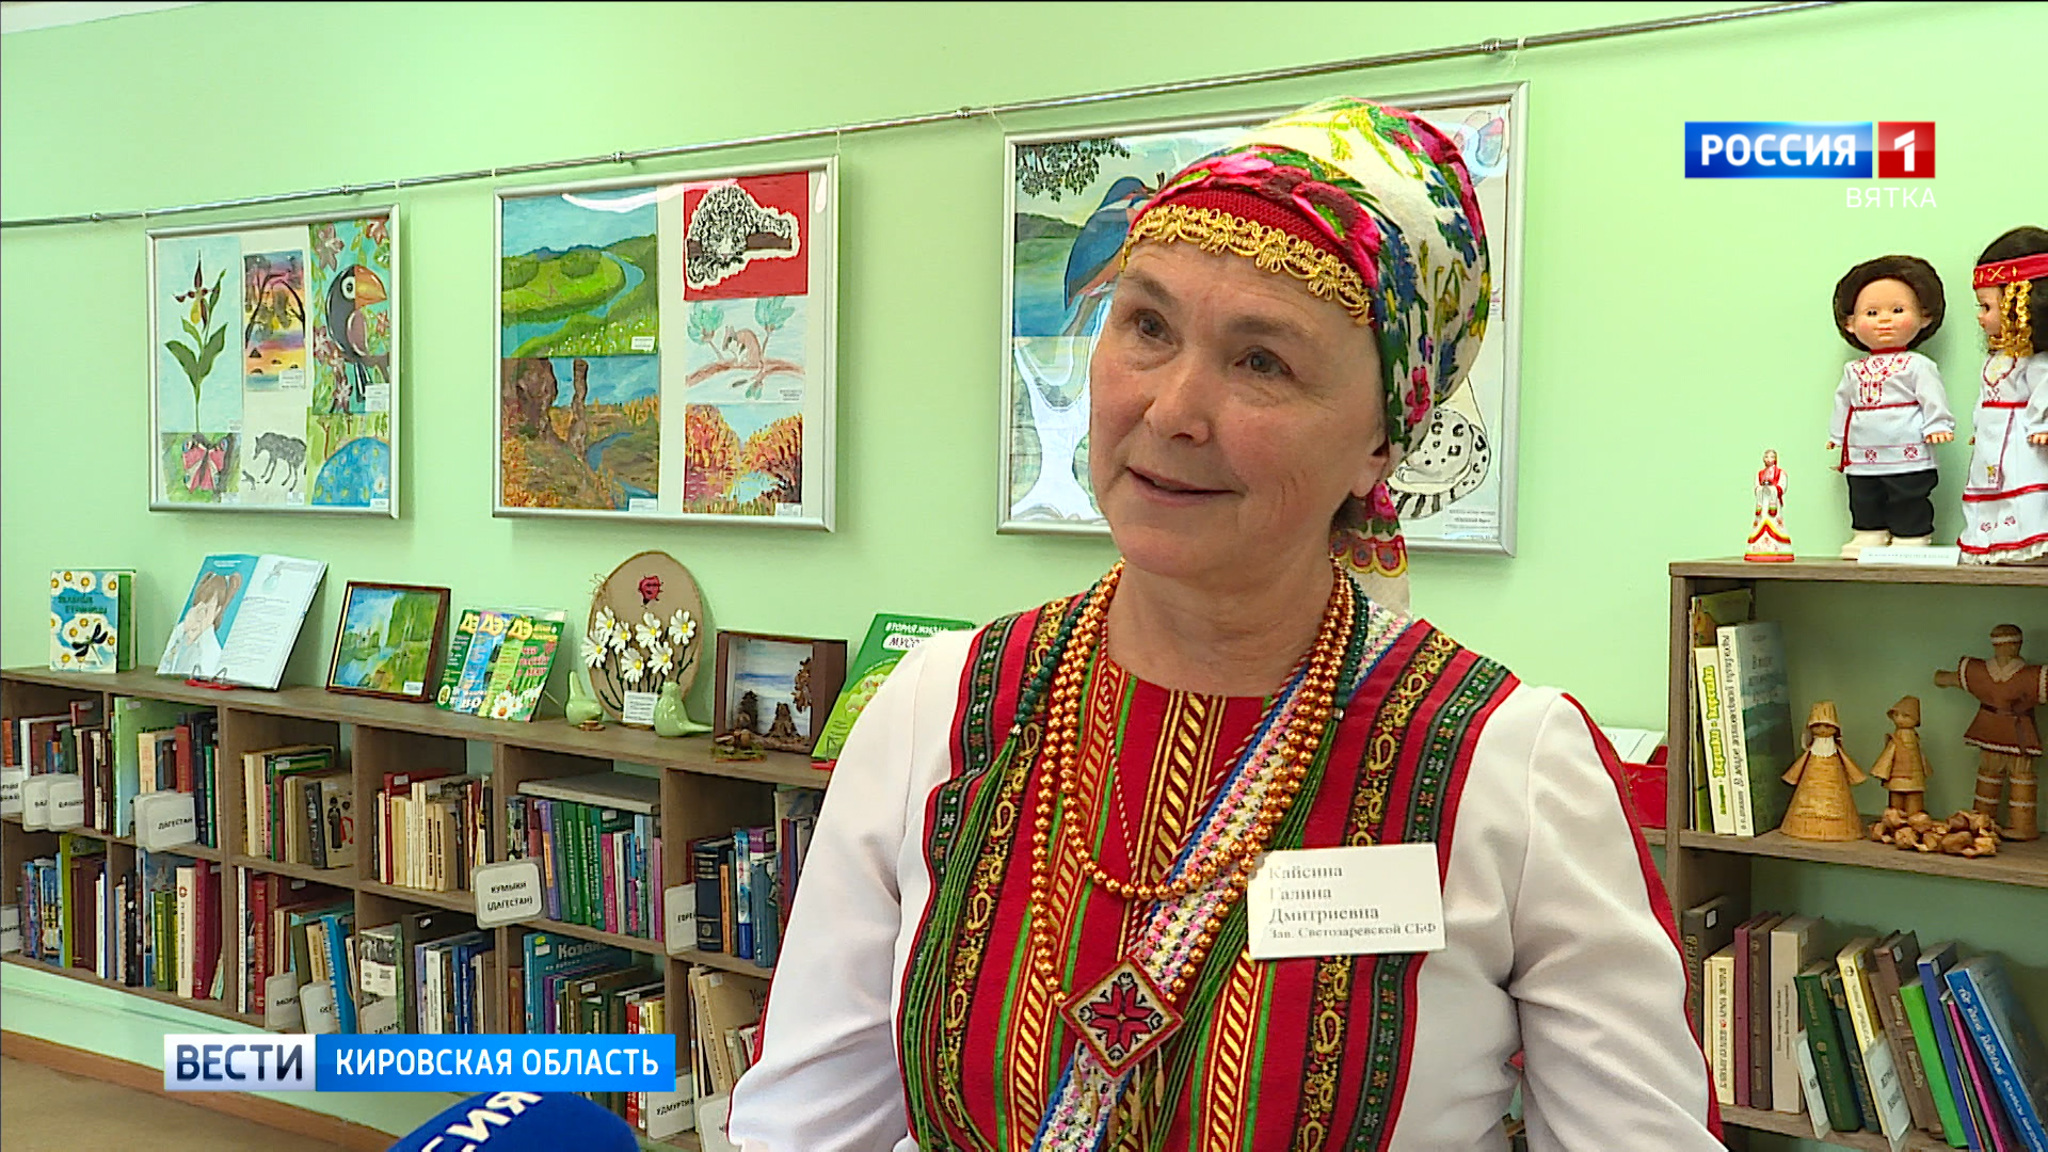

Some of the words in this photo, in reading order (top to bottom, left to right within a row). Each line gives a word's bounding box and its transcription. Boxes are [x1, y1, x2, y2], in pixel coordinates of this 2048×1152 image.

[1269, 865, 1343, 879] Кайсина
[490, 881, 527, 894] КУМЫКИ
[1270, 887, 1332, 900] Галина
[487, 895, 533, 911] (ДАГЕСТАН)
[1268, 907, 1379, 925] Дмитриевна
[1298, 923, 1401, 938] Светозаревской
[1404, 922, 1437, 934] СБФ
